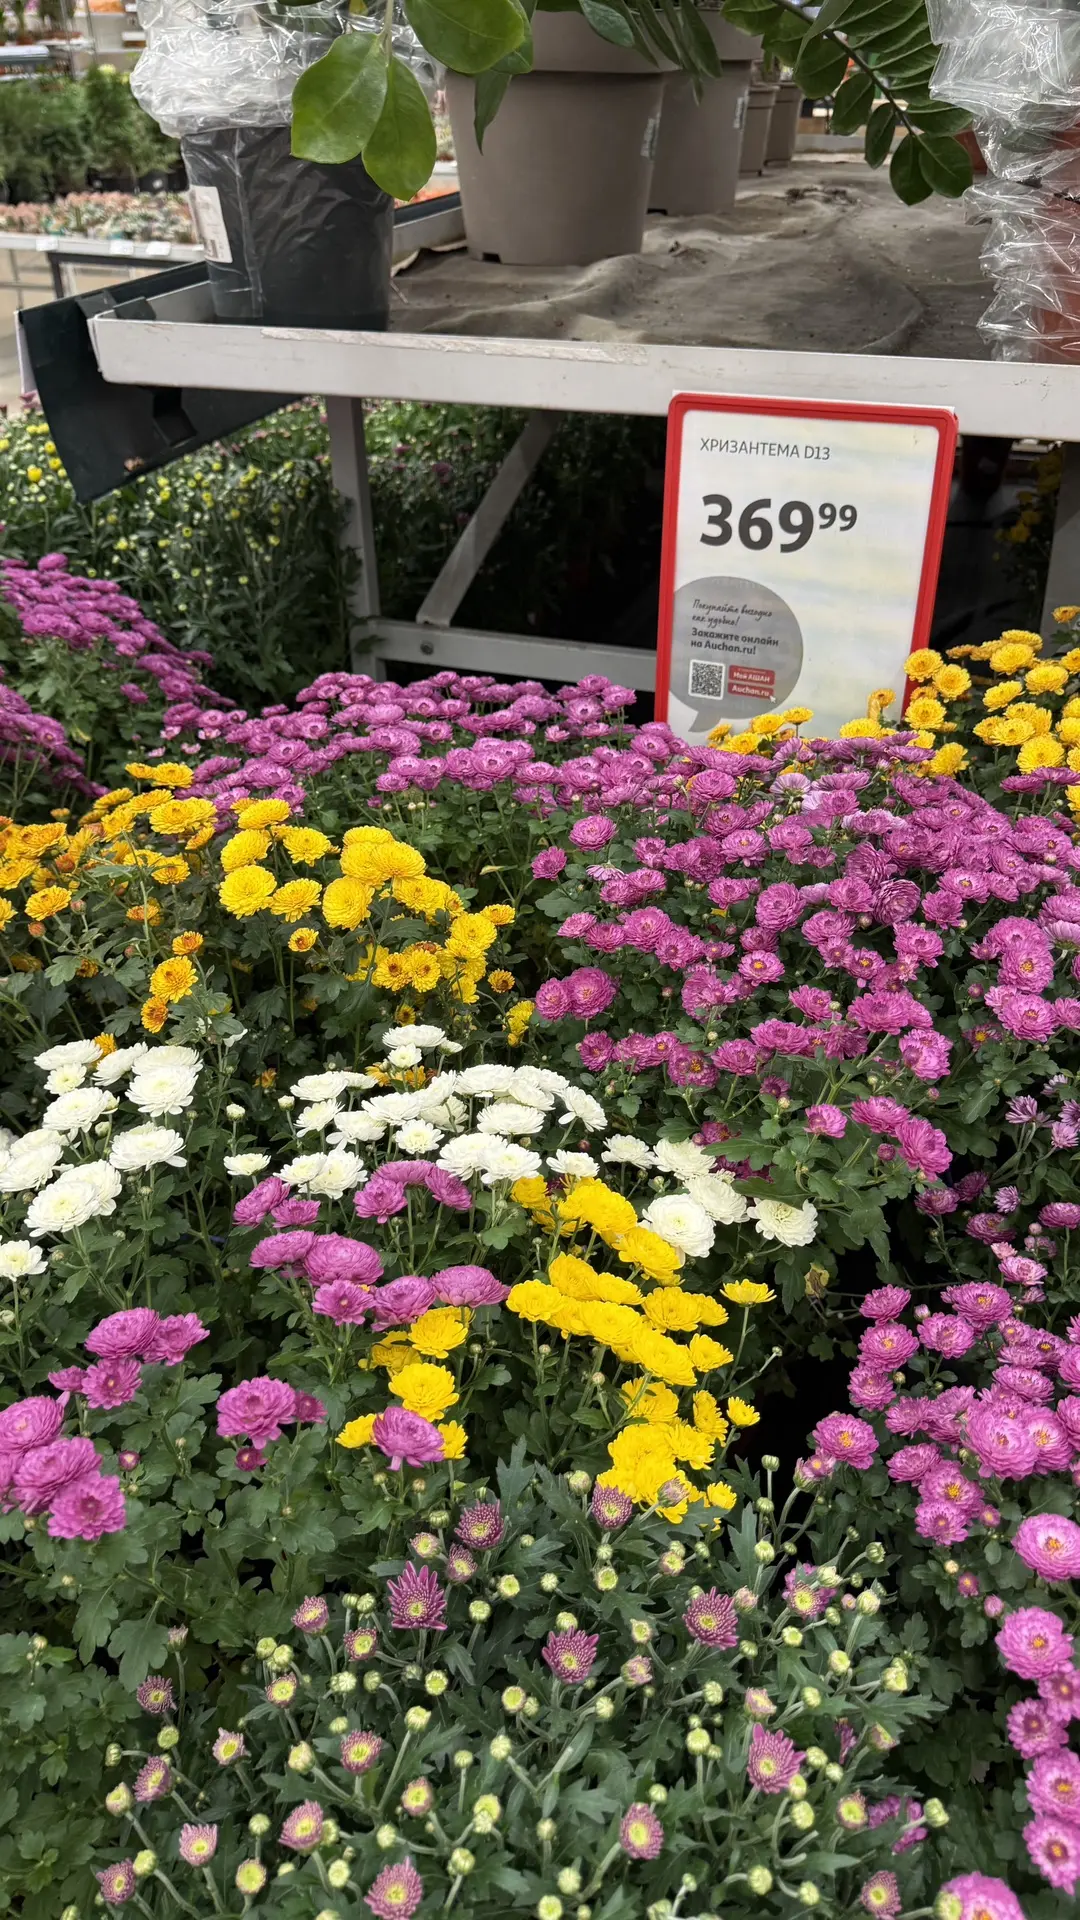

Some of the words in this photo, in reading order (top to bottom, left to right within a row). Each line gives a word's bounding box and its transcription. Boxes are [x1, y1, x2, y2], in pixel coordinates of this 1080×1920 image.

[700, 437, 800, 458] ХРИЗАНТЕМА
[804, 445, 831, 460] D13
[700, 494, 814, 554] 369
[818, 502, 858, 532] 99
[691, 628, 740, 642] Закажите
[741, 636, 779, 647] онлайн
[690, 640, 703, 648] на
[704, 640, 756, 655] Auchan.ru!
[732, 685, 770, 696] Auchan.ru
